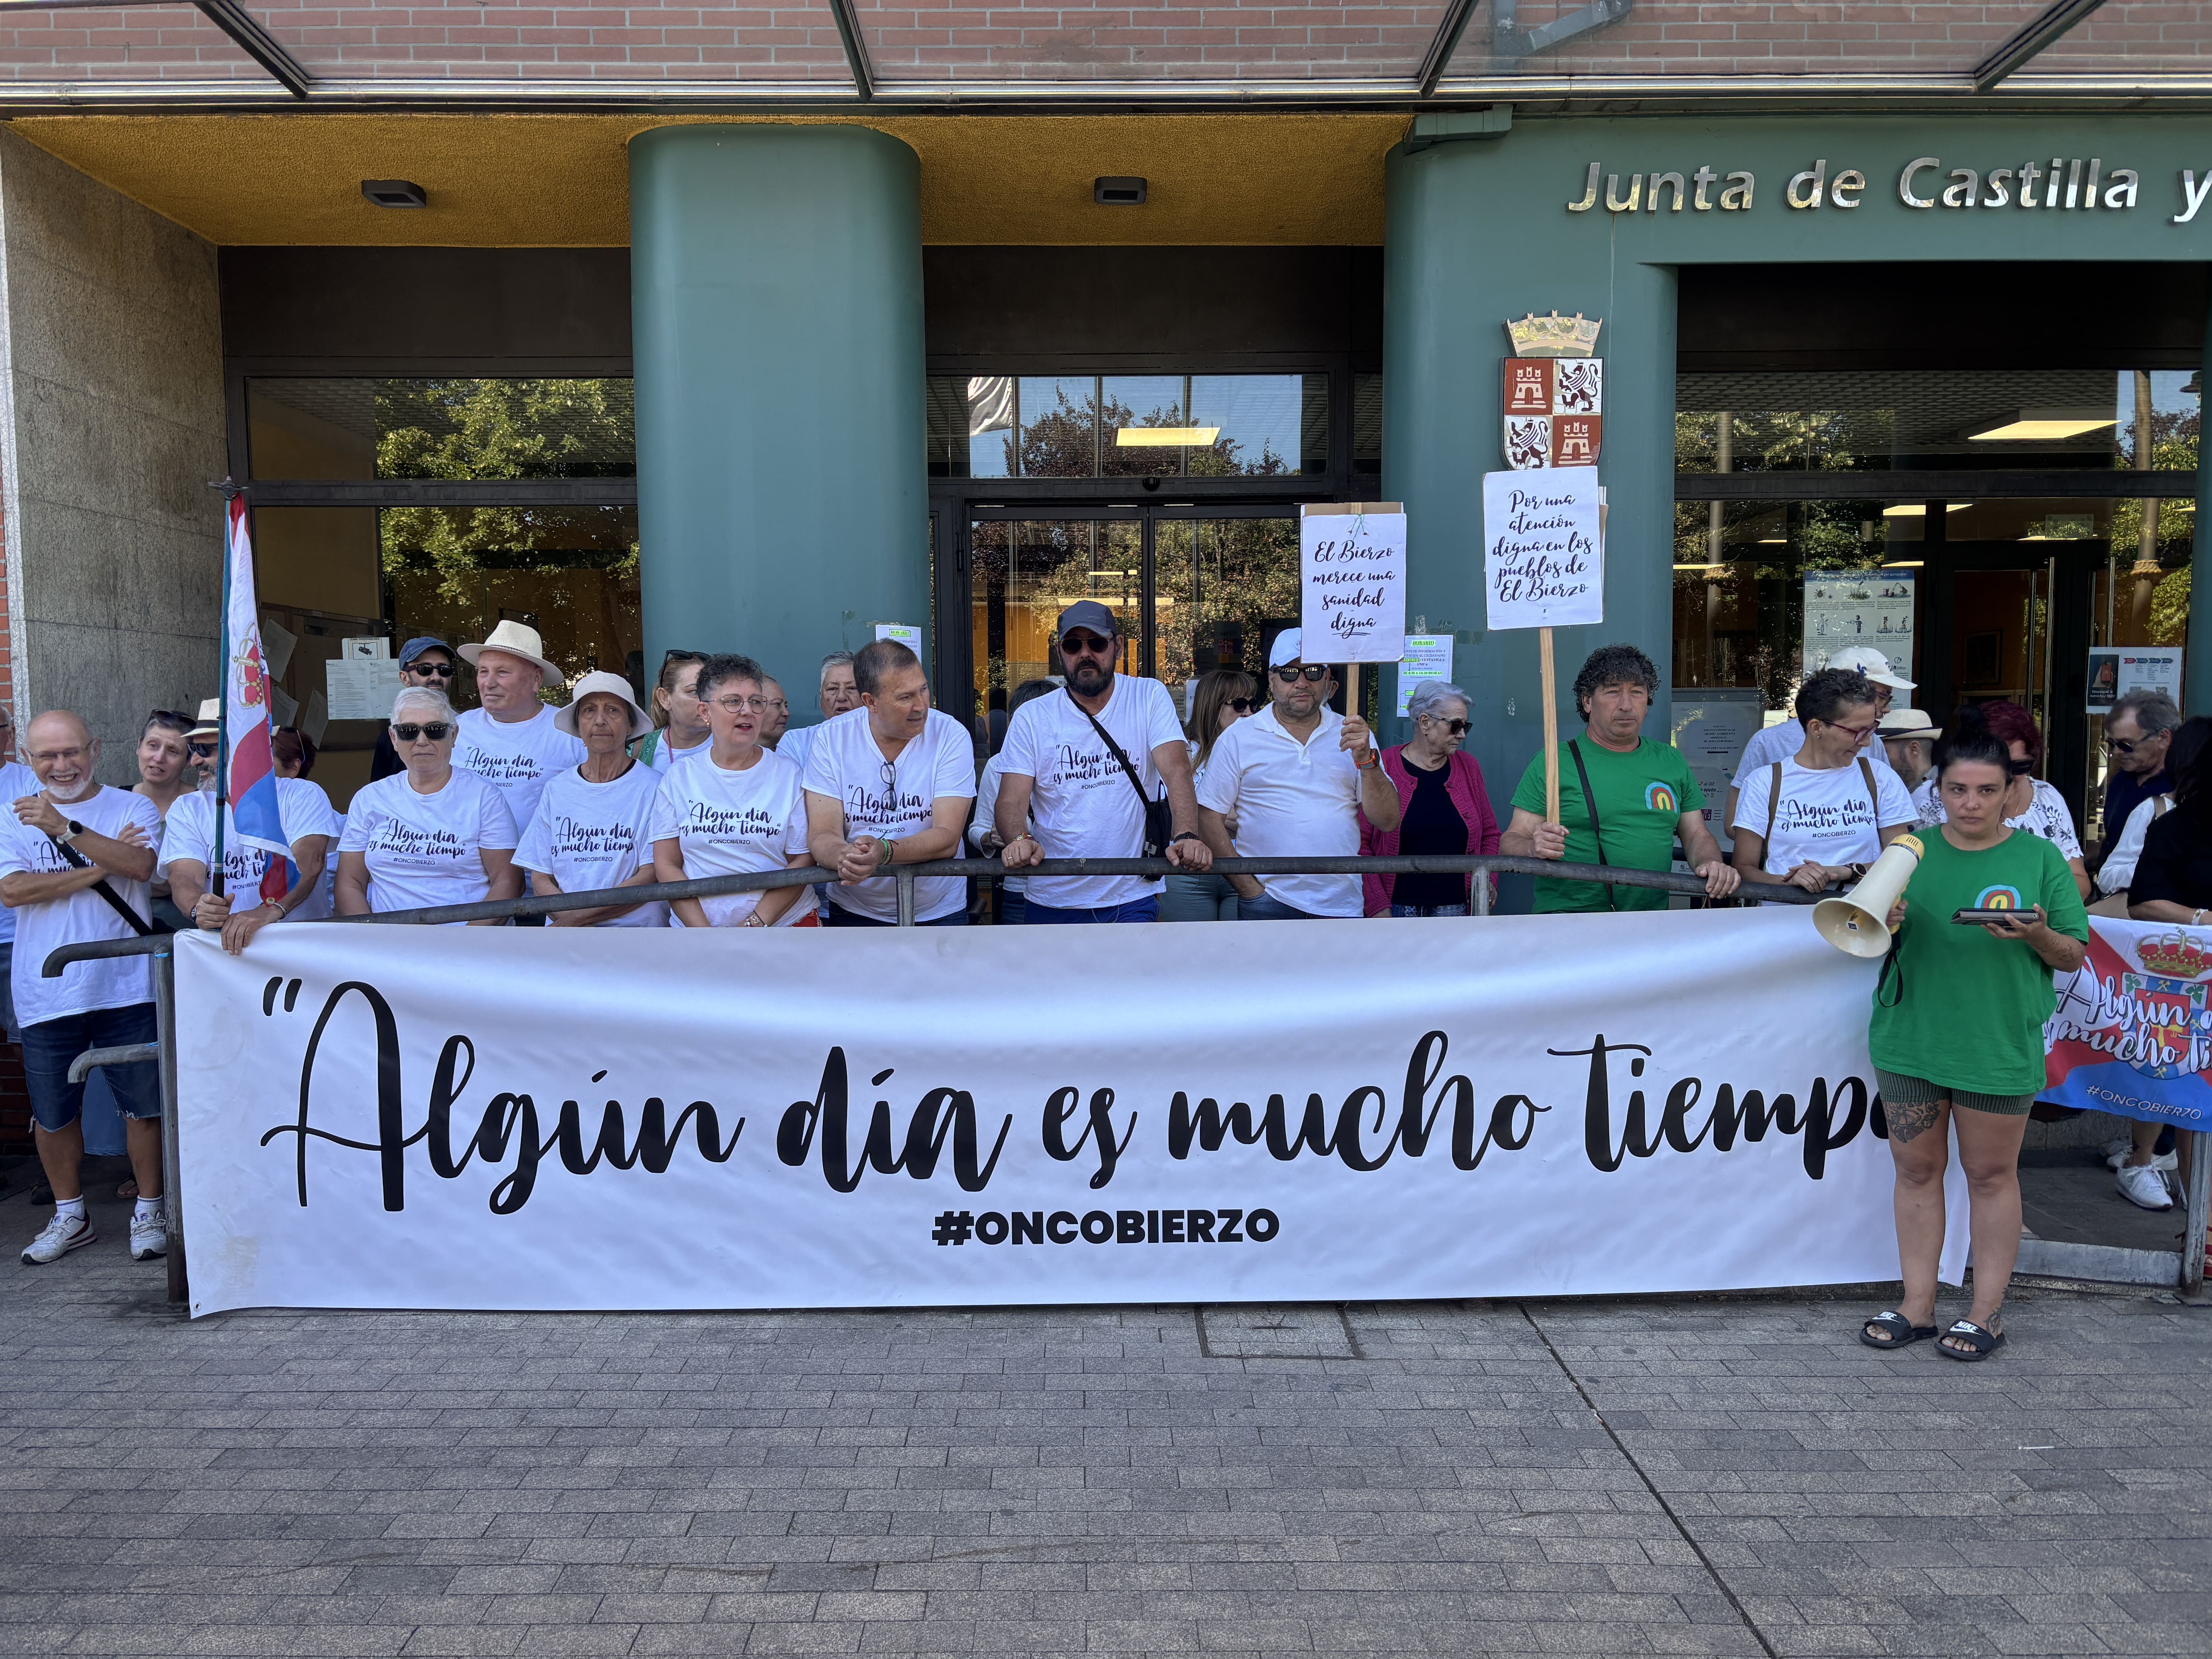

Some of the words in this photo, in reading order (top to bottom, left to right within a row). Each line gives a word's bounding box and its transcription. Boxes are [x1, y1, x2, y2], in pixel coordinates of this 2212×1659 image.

[1566, 162, 1755, 213] Junta
[1786, 159, 1867, 211] de
[1898, 157, 2139, 211] Castilla
[2172, 169, 2212, 224] y
[1508, 490, 1542, 513] Por
[1545, 495, 1576, 505] una
[1509, 512, 1575, 534] atención
[1314, 541, 1335, 562] El
[1338, 540, 1395, 563] Bierzo
[1492, 536, 1543, 565] digna
[1546, 542, 1565, 551] en
[1568, 531, 1593, 554] los
[1313, 571, 1365, 585] merece
[1368, 571, 1396, 580] una
[1494, 555, 1562, 589] pueblos
[1565, 554, 1588, 574] de
[1322, 587, 1385, 610] sanidad
[1500, 579, 1522, 602] El
[1526, 577, 1589, 601] Bierzo
[1331, 611, 1376, 639] digna
[512, 754, 537, 768] día
[1054, 773, 1062, 785] es
[1065, 764, 1102, 780] mucho
[1081, 780, 1115, 789] #ONCOBIERZO
[745, 807, 772, 823] día
[853, 809, 895, 824] mucho
[1844, 799, 1866, 813] día
[610, 823, 634, 839] día
[682, 824, 689, 836] es
[692, 819, 735, 834] mucho
[1793, 815, 1839, 828] mucho
[369, 840, 378, 852] es
[380, 840, 424, 854] mucho
[433, 830, 459, 844] día
[551, 845, 559, 857] es
[562, 836, 601, 853] mucho
[601, 837, 633, 854] tiemp
[393, 857, 435, 865] #ONCOBIERZO
[2058, 1020, 2181, 1068] mucho
[776, 1046, 1013, 1192] día
[1042, 1086, 1137, 1190] es
[1168, 1030, 1552, 1172] mucho
[2086, 1085, 2202, 1119] #ONCOBIERZO
[931, 1208, 1279, 1246] #ONCOBIERZO
[1956, 1321, 1979, 1332] NIKE
